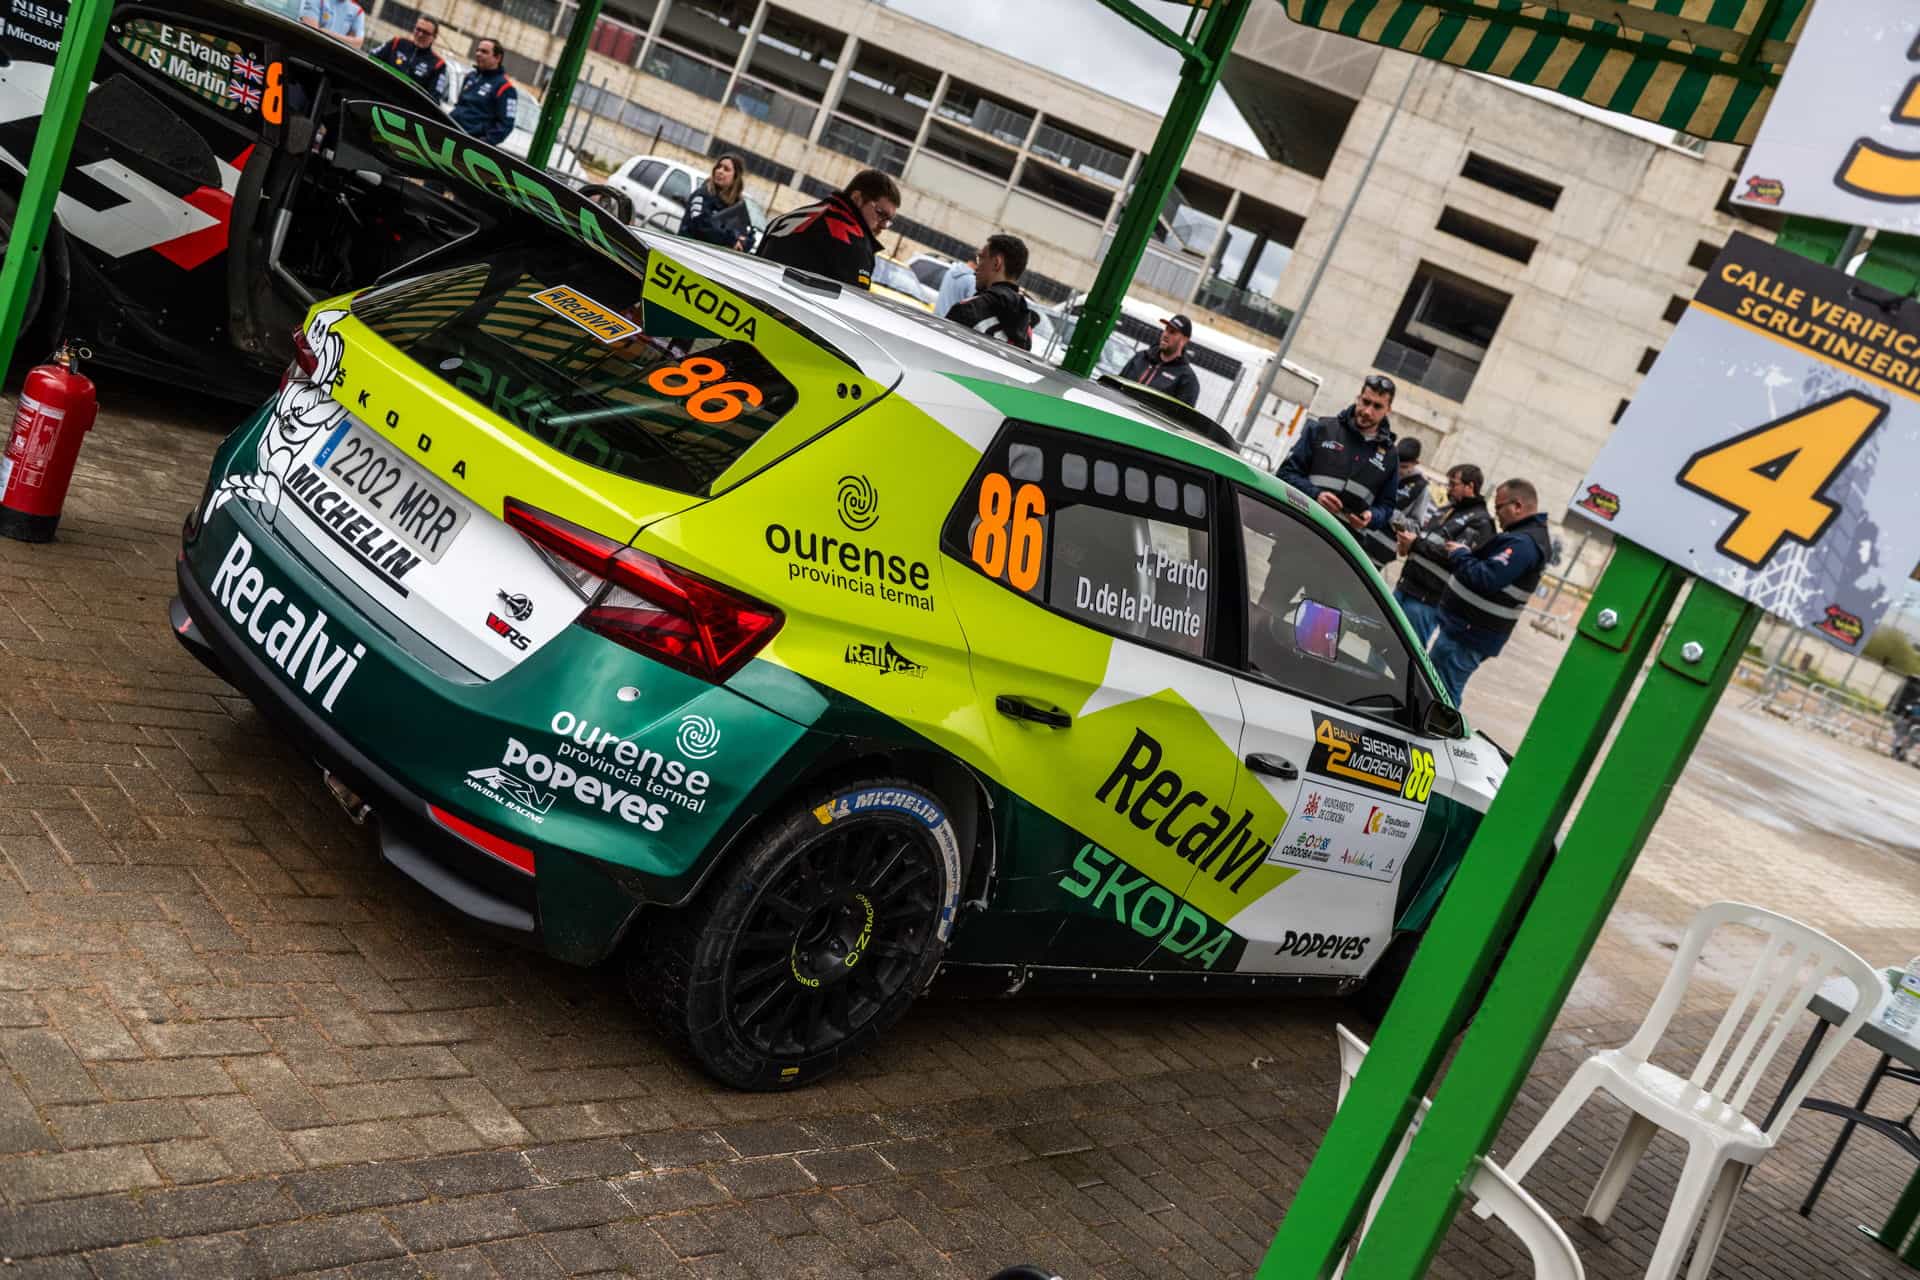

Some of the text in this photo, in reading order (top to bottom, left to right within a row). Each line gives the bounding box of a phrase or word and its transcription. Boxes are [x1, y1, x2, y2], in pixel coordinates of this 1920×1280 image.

[7, 23, 62, 52] Microsof
[11, 0, 66, 24] NISU
[148, 47, 227, 97] S.Martin
[160, 24, 232, 71] E.Evans
[559, 295, 614, 331] Recalvi
[1720, 263, 1920, 359] CALLE VERIFIC
[1736, 297, 1920, 391] SCRUTINEERI
[649, 357, 764, 424] 86
[330, 437, 402, 510] 2202
[390, 481, 457, 552] MRR
[1675, 389, 1891, 572] 4
[286, 463, 423, 579] MICHELIN
[971, 472, 1047, 593] 86
[765, 523, 929, 591] ourense
[788, 561, 935, 612] provincia termal
[1156, 551, 1207, 592] Pardo
[211, 531, 367, 713] Recalvi
[1138, 593, 1201, 638] Puente
[551, 711, 710, 796] ourense
[1333, 726, 1407, 764] RALLY SIERRA
[1349, 752, 1404, 782] MORENA
[1405, 748, 1436, 803] 86
[464, 778, 544, 824] ARVIDAL RACING
[557, 740, 706, 814] provincia termal
[855, 791, 940, 824] MICHELIN
[1095, 727, 1278, 895] Recalvi
[1057, 843, 1234, 970] SKODA
